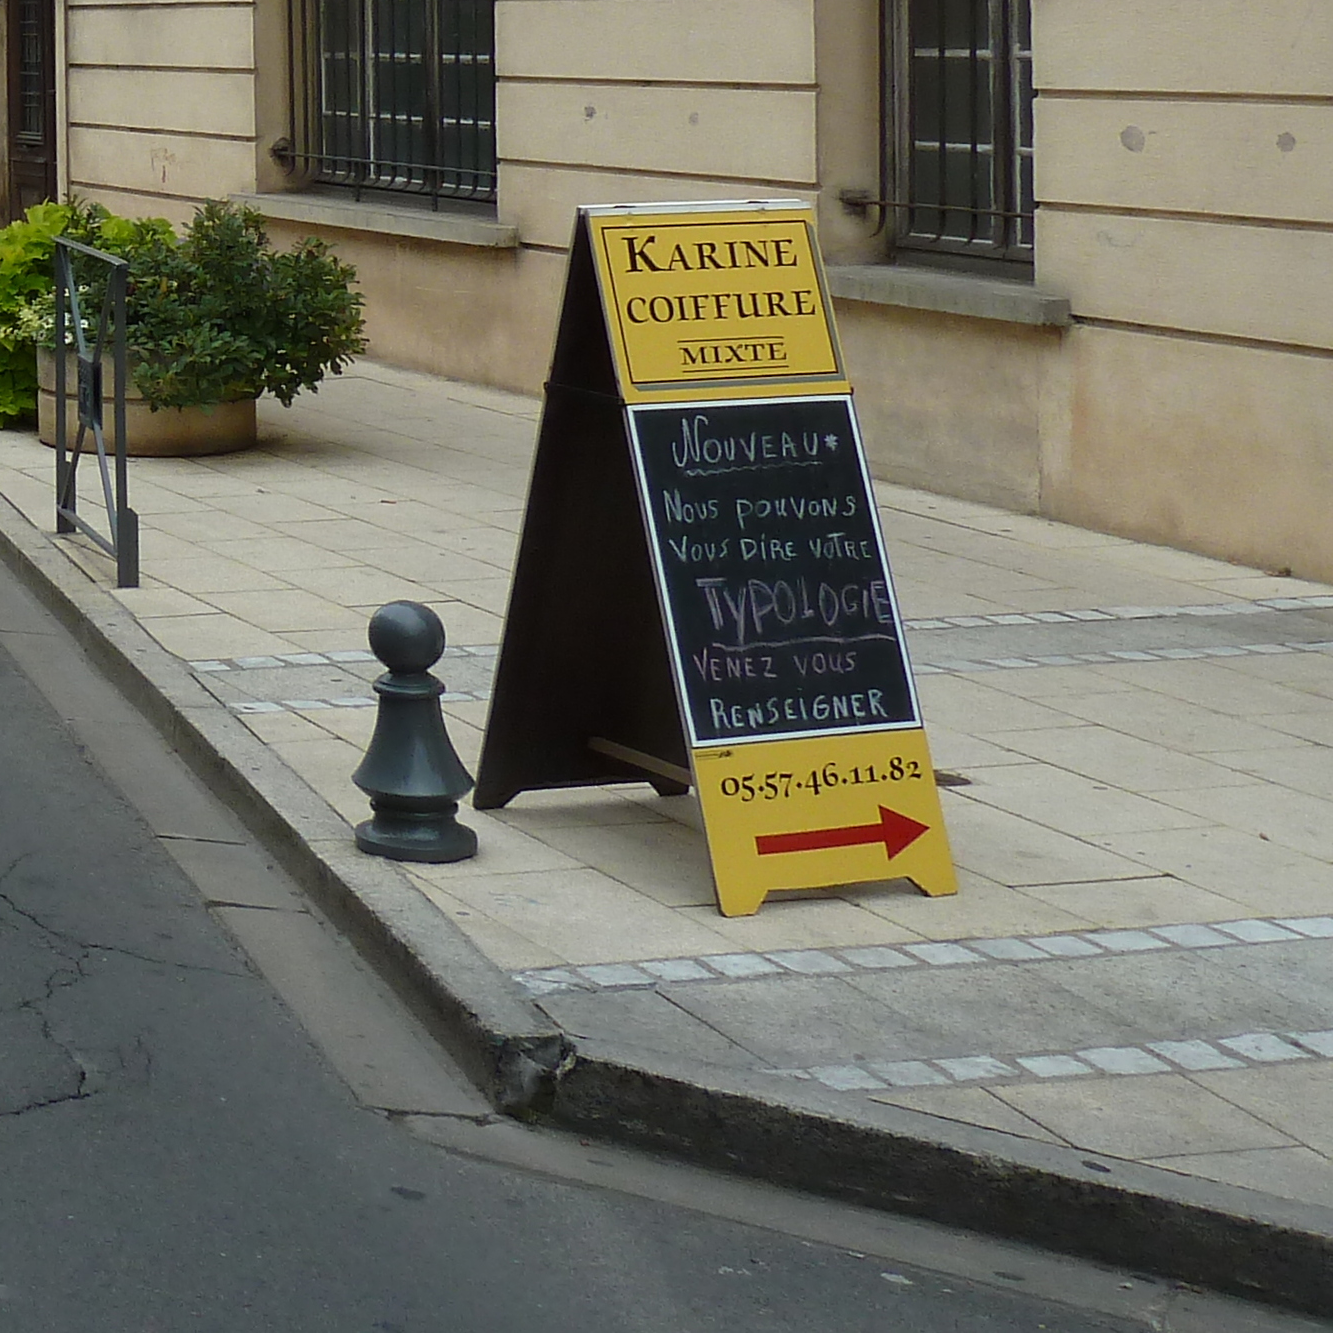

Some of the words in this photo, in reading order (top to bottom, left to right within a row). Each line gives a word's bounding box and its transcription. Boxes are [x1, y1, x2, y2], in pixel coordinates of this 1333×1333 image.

[621, 236, 798, 273] KARINE
[626, 290, 817, 324] COIFFURE
[679, 342, 788, 366] MIXTE
[668, 535, 730, 563] VOUS
[693, 647, 778, 683] VENEZ
[793, 650, 858, 677] VOUS
[720, 756, 923, 803] 05.57.46.11.82
